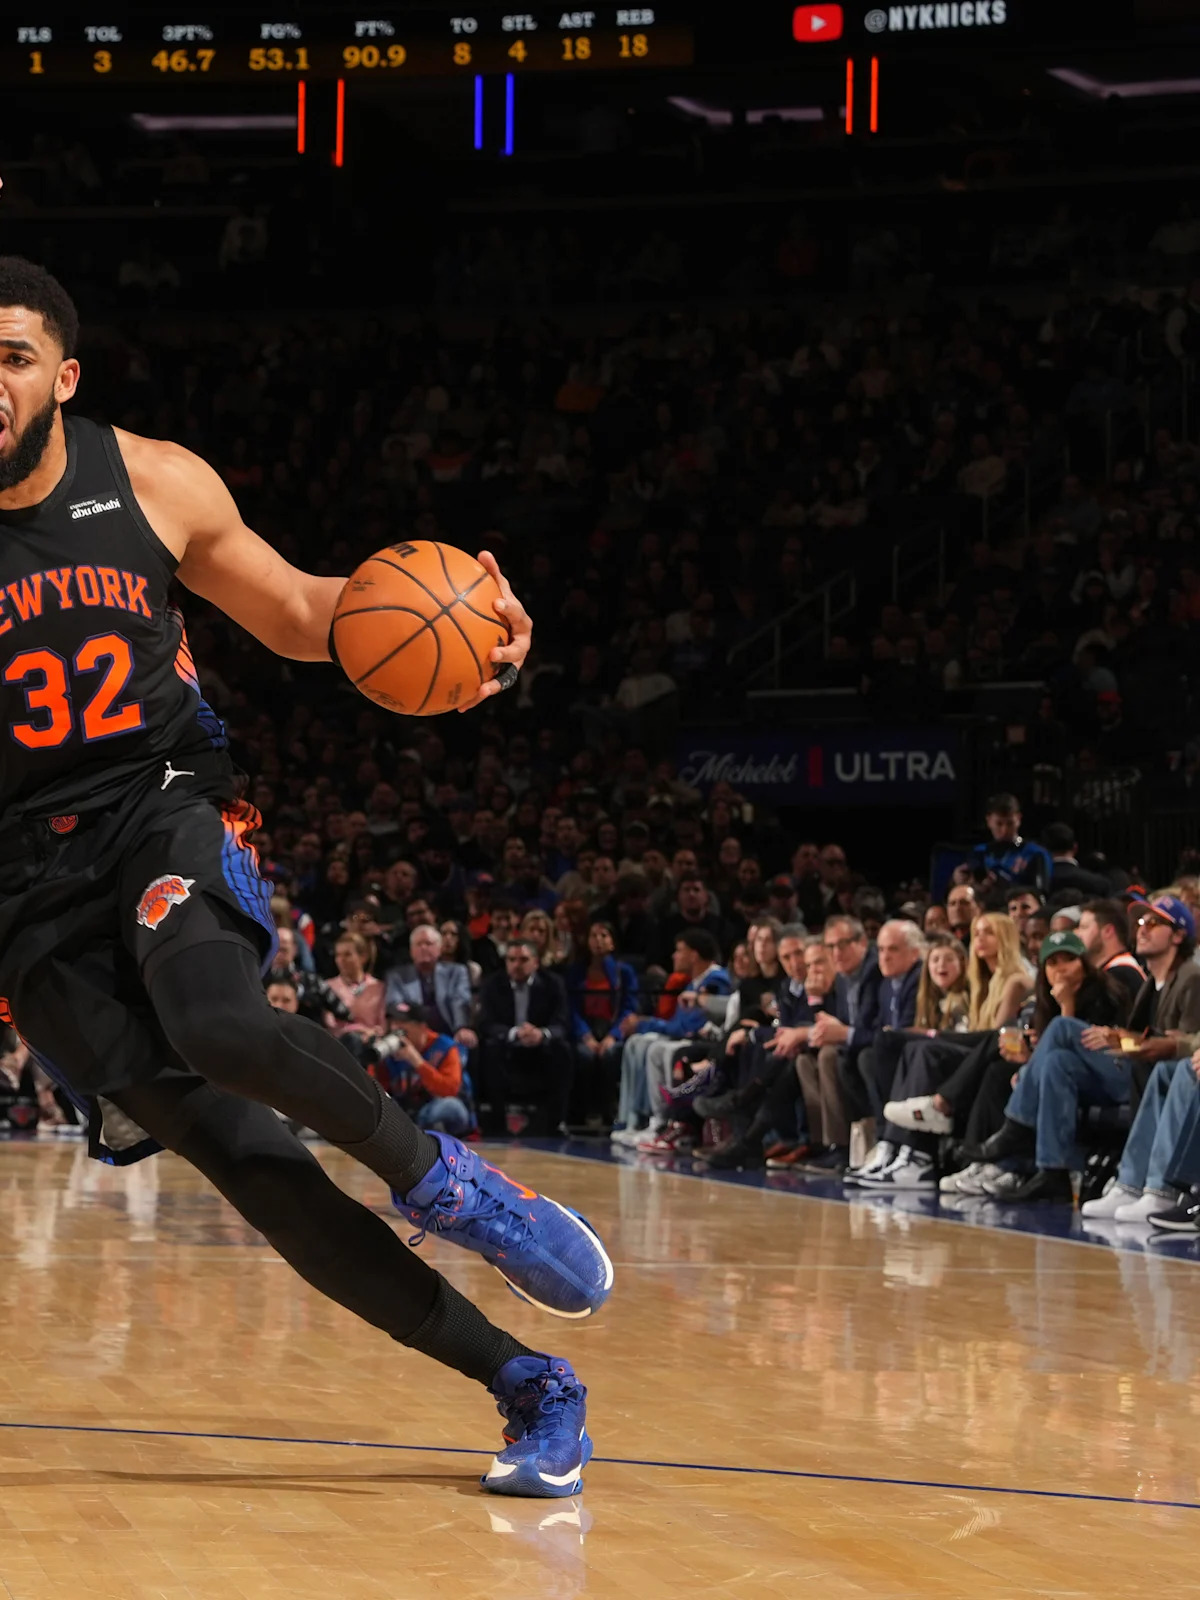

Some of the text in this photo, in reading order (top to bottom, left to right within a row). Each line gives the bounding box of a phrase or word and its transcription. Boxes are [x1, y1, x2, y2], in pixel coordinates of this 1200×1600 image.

[17, 9, 655, 43] FLS TOL 3PT% FG% FT% TO STL AST REB
[864, 0, 1006, 33] @NYKNICKS
[29, 34, 648, 74] 1 3 46.7 53.1 90.9 8 4 18 18
[72, 498, 121, 519] abu dhabi
[45, 564, 153, 620] YORK
[1, 630, 147, 749] 32
[834, 750, 956, 783] ULTRA
